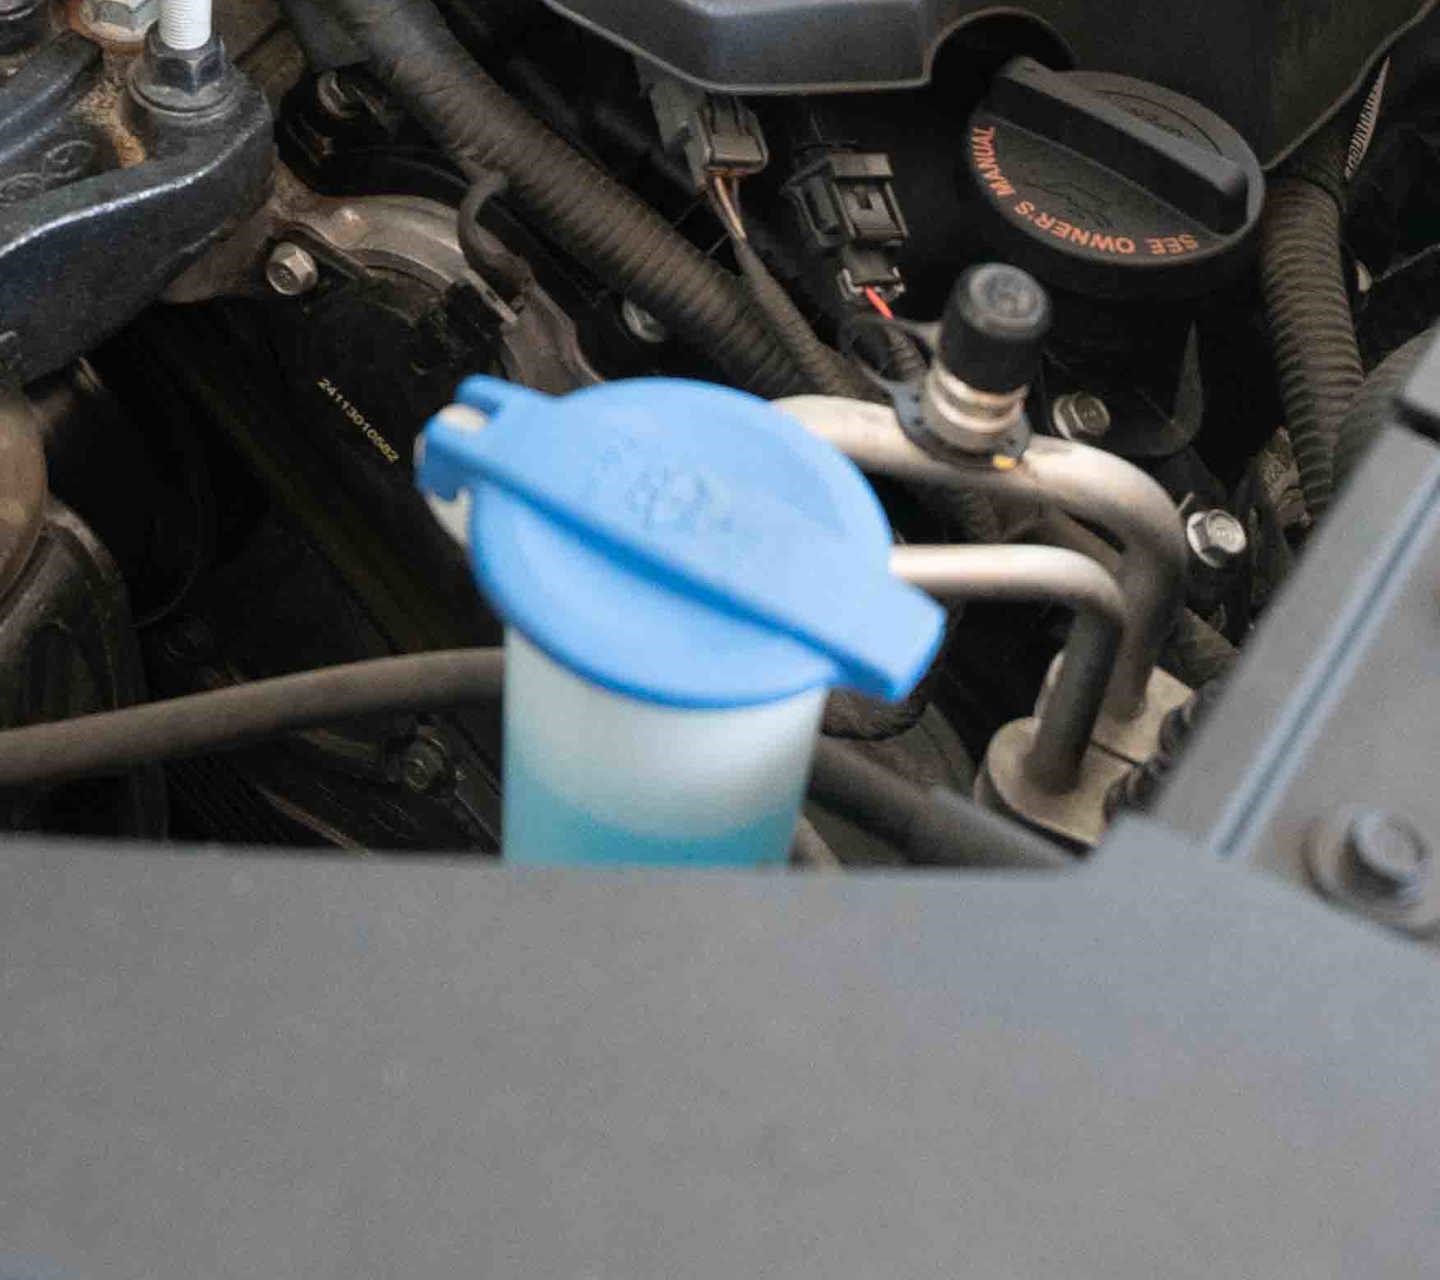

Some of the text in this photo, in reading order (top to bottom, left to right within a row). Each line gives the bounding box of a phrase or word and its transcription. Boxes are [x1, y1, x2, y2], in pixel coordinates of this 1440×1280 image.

[971, 124, 1200, 257] SEE OWNER'S MANUAL
